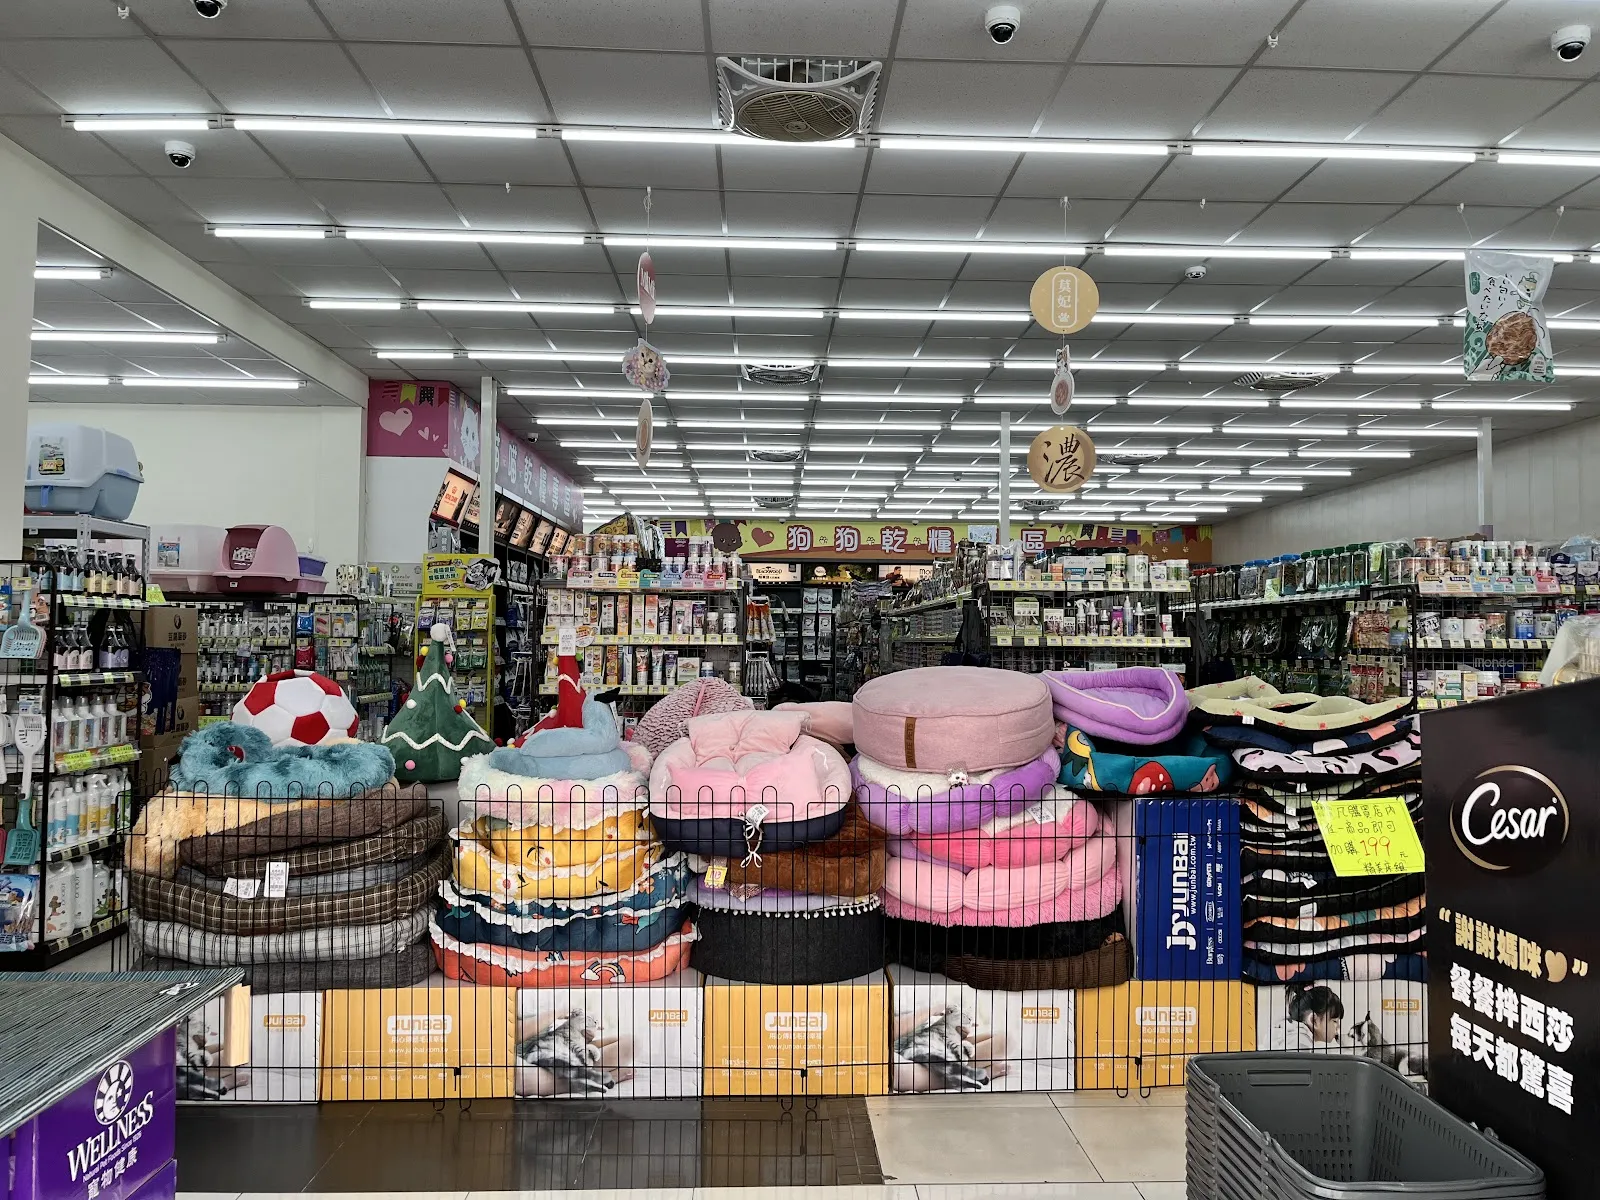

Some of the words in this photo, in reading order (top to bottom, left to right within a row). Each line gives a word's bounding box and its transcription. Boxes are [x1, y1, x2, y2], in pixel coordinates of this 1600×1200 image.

[1044, 433, 1085, 484] 濃
[1360, 836, 1391, 856] 199
[1462, 782, 1558, 846] Cesar
[1188, 835, 1197, 915] www.junbai.com.tw
[1450, 962, 1574, 1052] 餐餐拌西莎
[1450, 1012, 1574, 1115] 每天都驚喜
